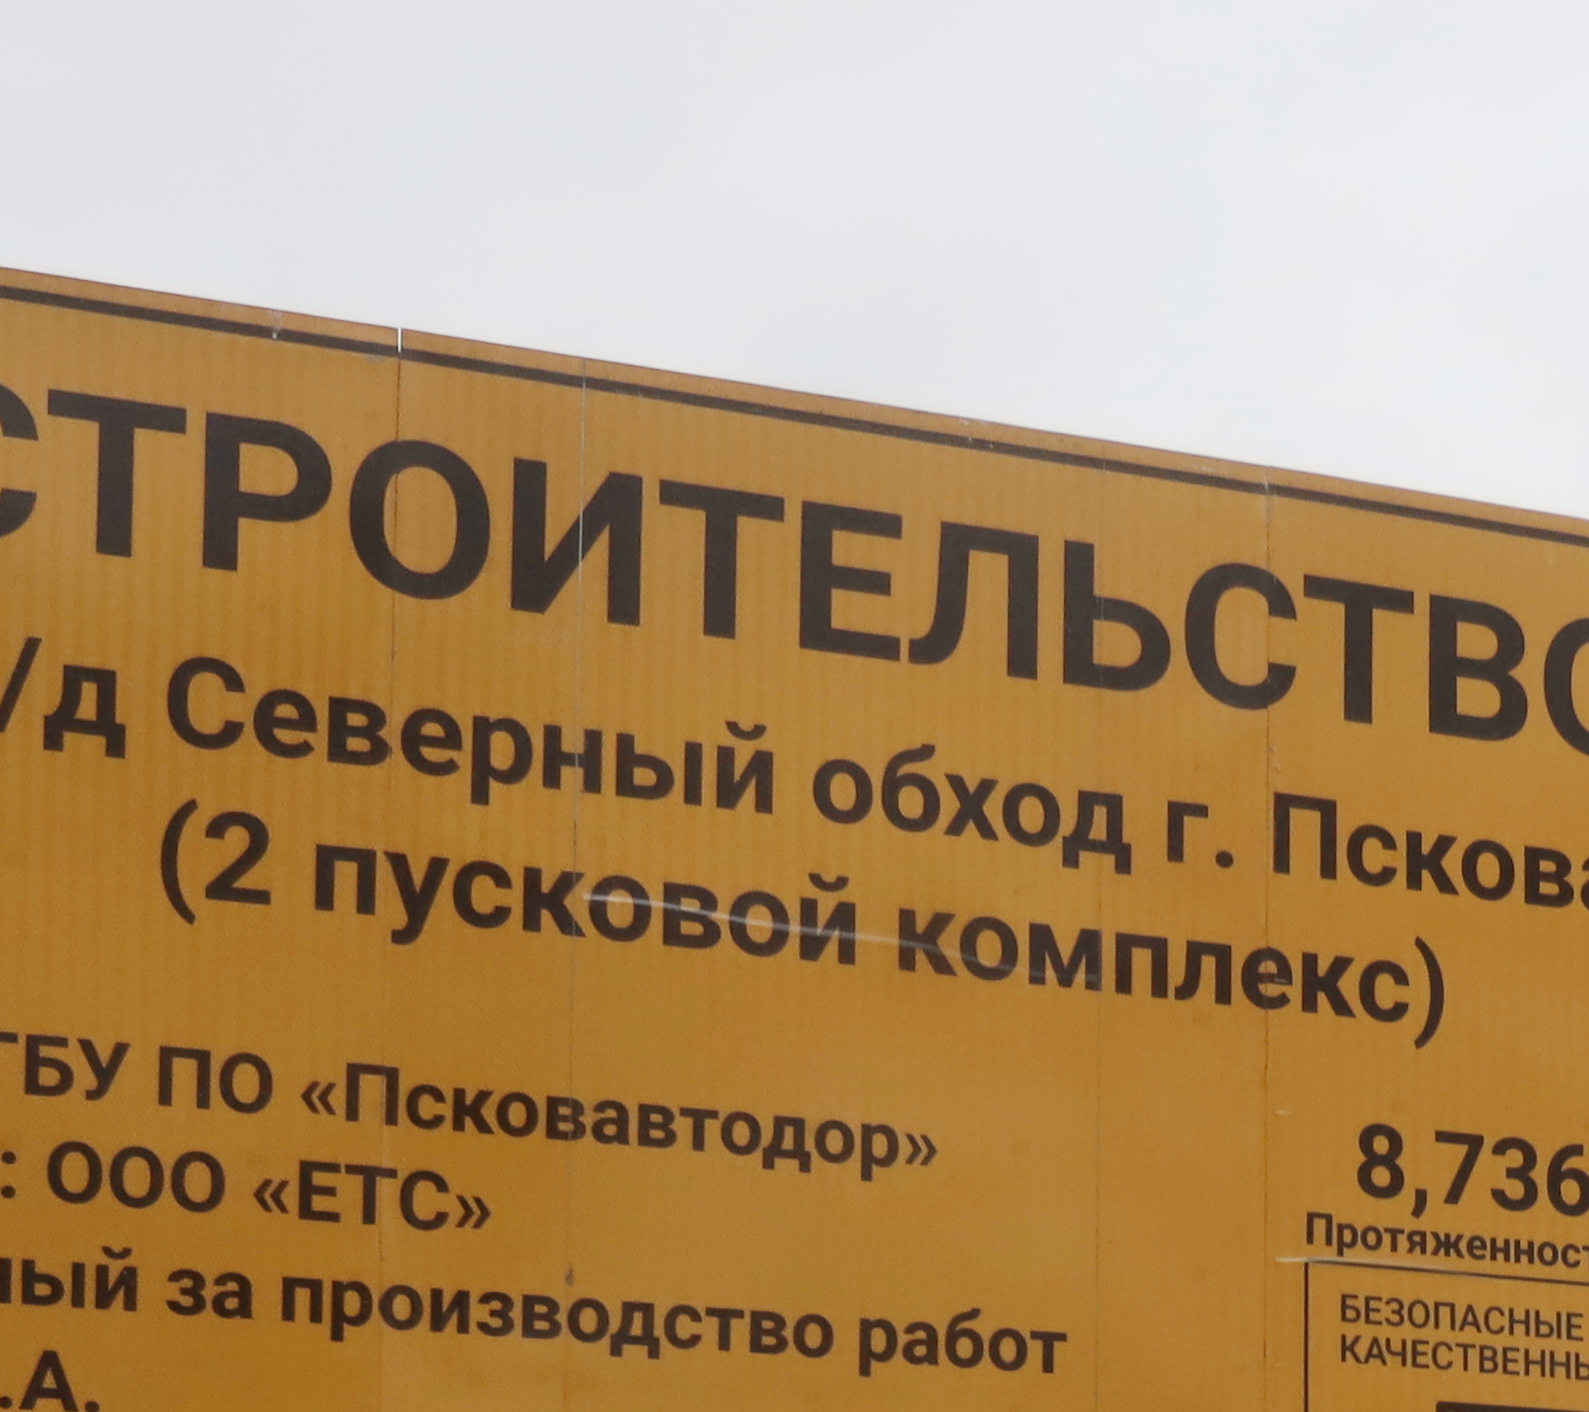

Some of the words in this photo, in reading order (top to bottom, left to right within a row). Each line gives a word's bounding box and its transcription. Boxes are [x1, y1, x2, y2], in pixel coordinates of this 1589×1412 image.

[167, 657, 773, 814] Северный
[813, 744, 1131, 875] обход
[1167, 801, 1233, 868] г.
[161, 799, 271, 924] (2
[315, 844, 856, 965] пусковой
[899, 908, 1444, 1048] комплекс)
[158, 1046, 273, 1114] ПО
[301, 1063, 937, 1181] «Псковавтодор»
[47, 1141, 225, 1213] ООО
[253, 1160, 491, 1231] «ЕТС»
[166, 1269, 252, 1319] за
[282, 1277, 834, 1359] производство
[859, 1308, 1067, 1377] работ
[1341, 1294, 1583, 1341] БЕЗОПАСНЫЕ
